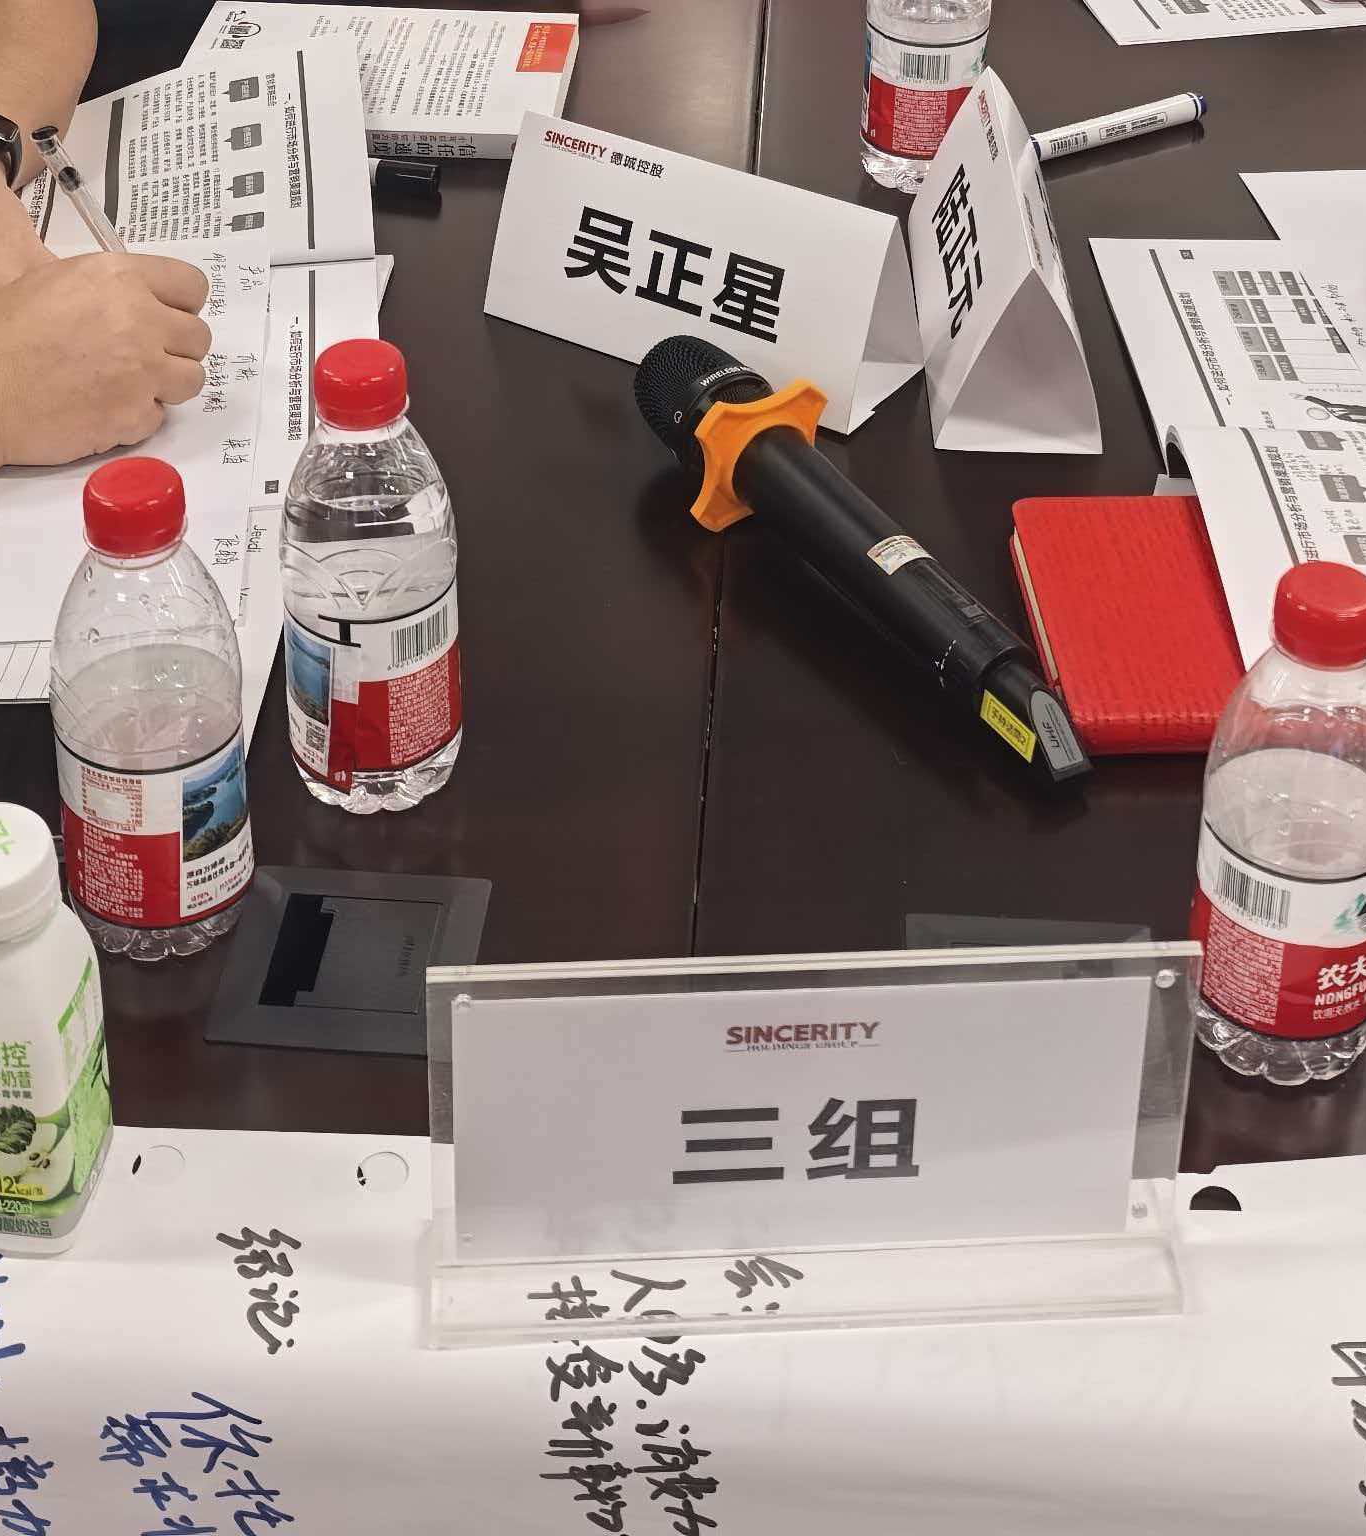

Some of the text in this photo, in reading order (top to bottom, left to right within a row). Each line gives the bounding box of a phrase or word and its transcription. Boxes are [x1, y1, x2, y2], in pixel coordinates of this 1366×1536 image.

[543, 128, 608, 160] SINCERITY
[564, 205, 786, 344] 吴正星
[931, 163, 983, 340] 陆正元
[1272, 445, 1323, 566] 进行市场分析与营销渠道规划
[1042, 720, 1060, 749] UHF
[725, 1020, 881, 1047] SINCERITY
[671, 1096, 921, 1185] 三组
